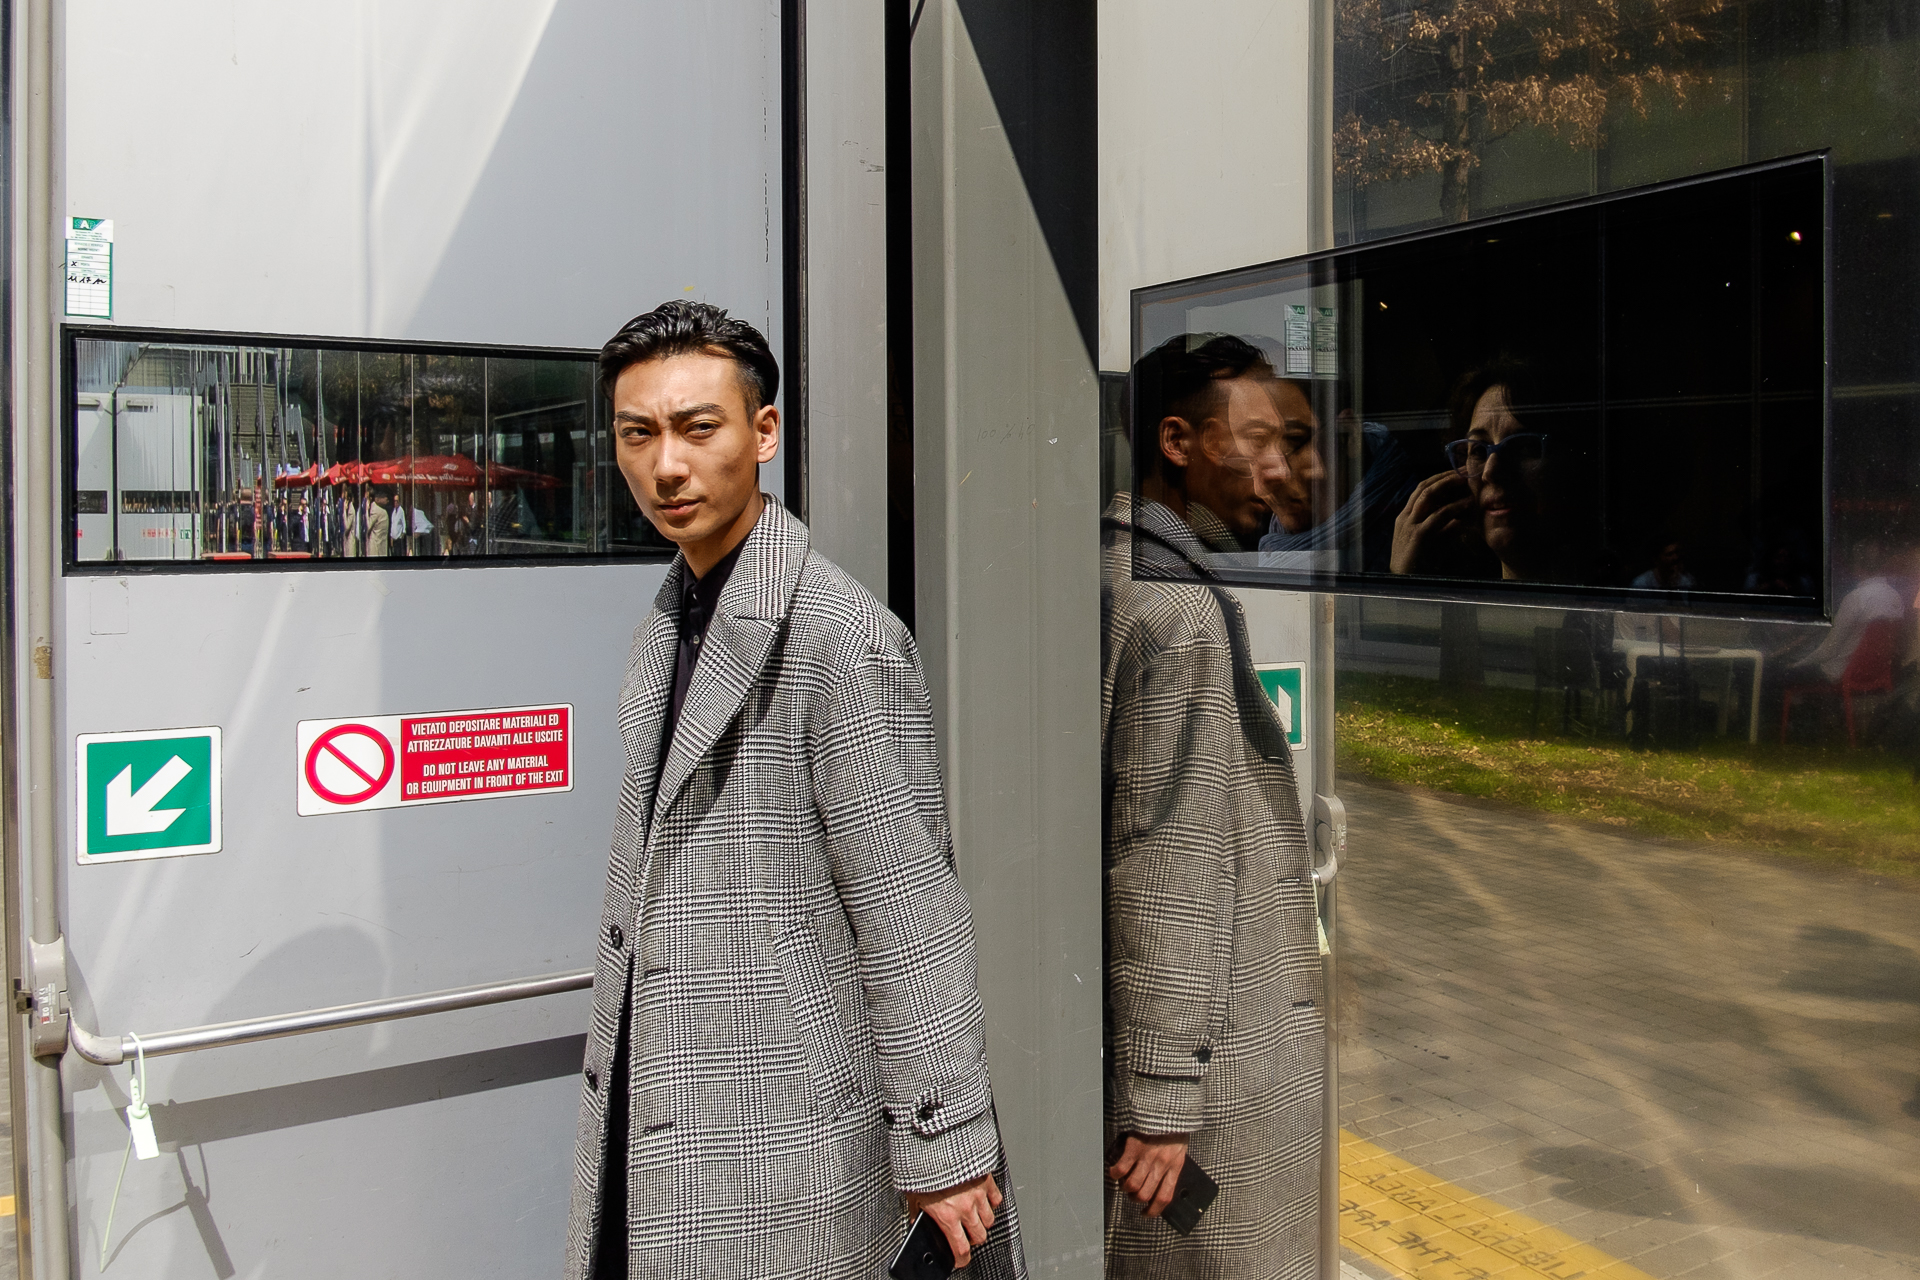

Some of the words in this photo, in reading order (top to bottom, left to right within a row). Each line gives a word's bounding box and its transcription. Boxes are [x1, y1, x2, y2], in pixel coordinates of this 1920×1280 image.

[411, 722, 447, 735] VIETATO
[449, 718, 500, 732] DEPOSITARE
[503, 715, 546, 729] MATERIALI
[549, 714, 559, 725] ED
[407, 737, 472, 752] ATTREZZATURE
[474, 734, 510, 747] DAVANTI
[513, 732, 533, 744] ALLE
[535, 730, 563, 742] USCITE
[423, 764, 435, 777] DO
[438, 762, 456, 775] NOT
[459, 760, 484, 773] LEAVE
[487, 759, 505, 771] ANY
[507, 756, 548, 769] MATERIAL
[406, 783, 419, 795] OR
[421, 778, 471, 793] EQUIPMENT
[474, 777, 483, 788] IN
[486, 774, 513, 787] FRONT
[515, 773, 526, 785] OF
[528, 772, 544, 784] THE
[546, 770, 563, 782] EXIT
